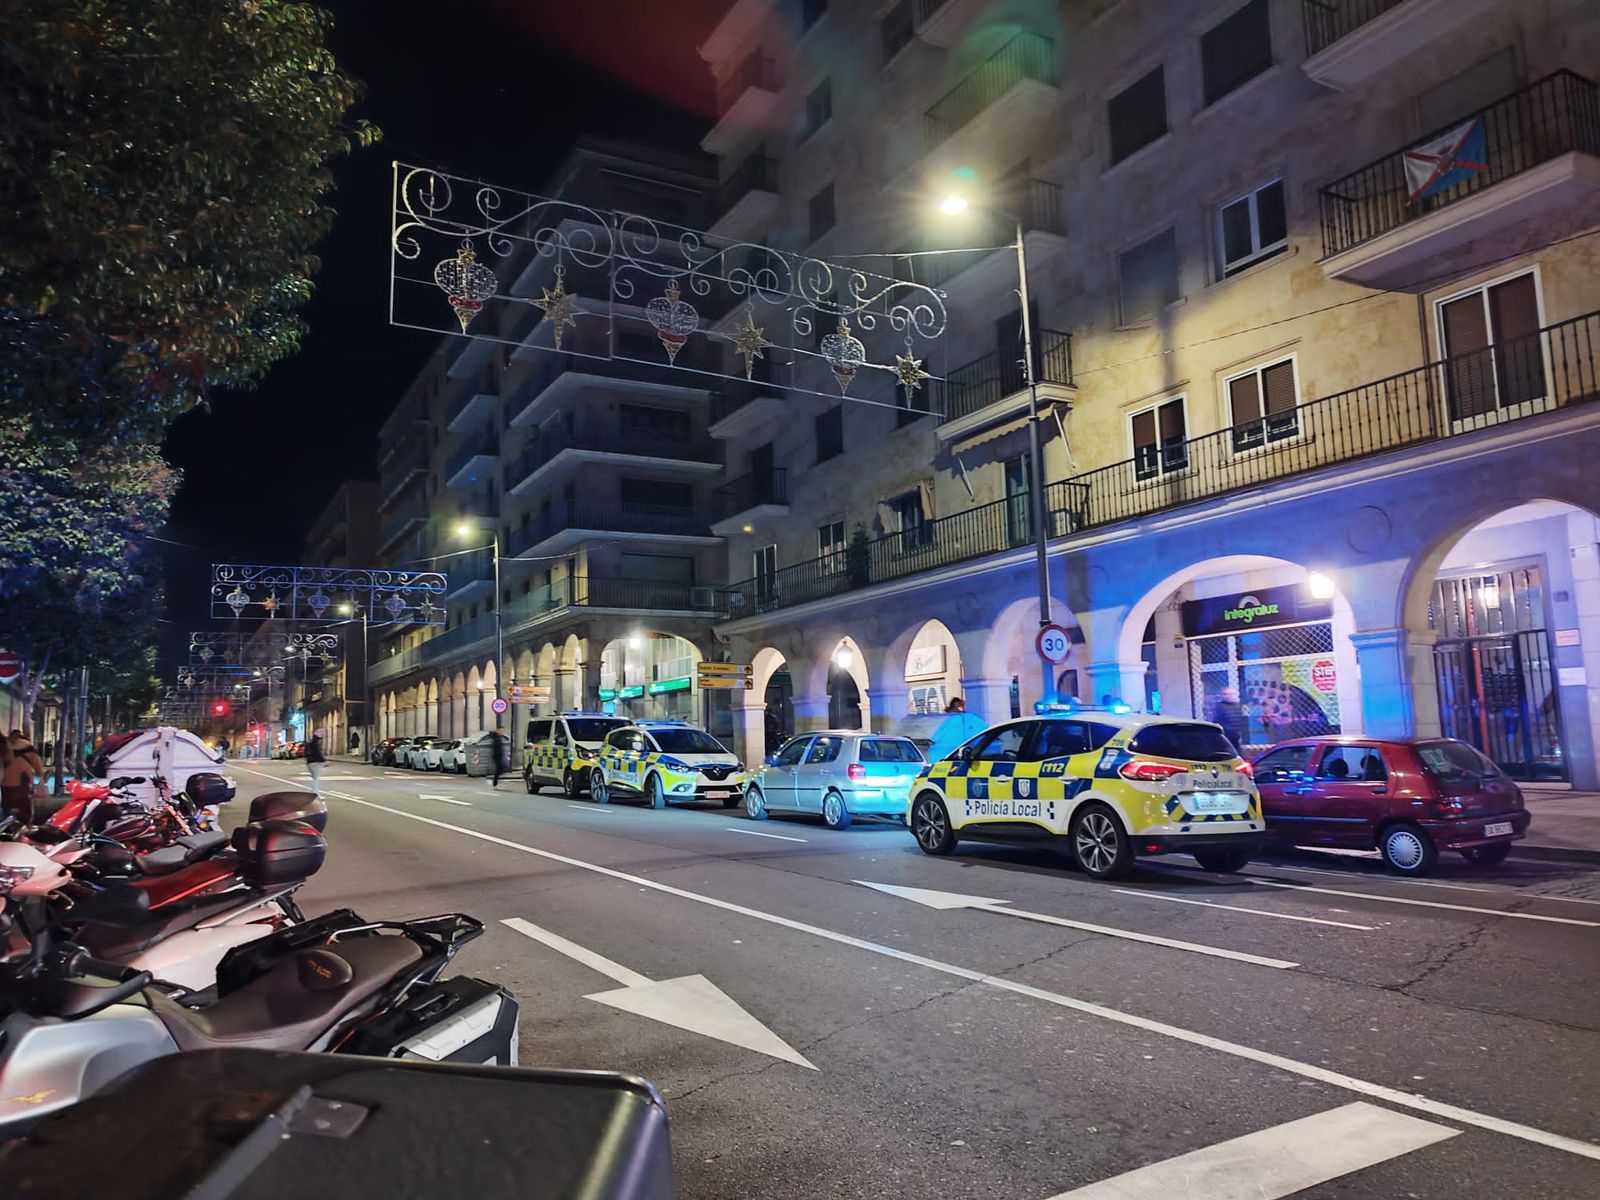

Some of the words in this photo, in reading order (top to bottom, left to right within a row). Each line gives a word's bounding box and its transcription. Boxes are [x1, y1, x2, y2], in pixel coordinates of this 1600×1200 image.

[1224, 604, 1279, 623] integraluz
[1045, 638, 1064, 651] 30
[1012, 801, 1042, 817] Local
